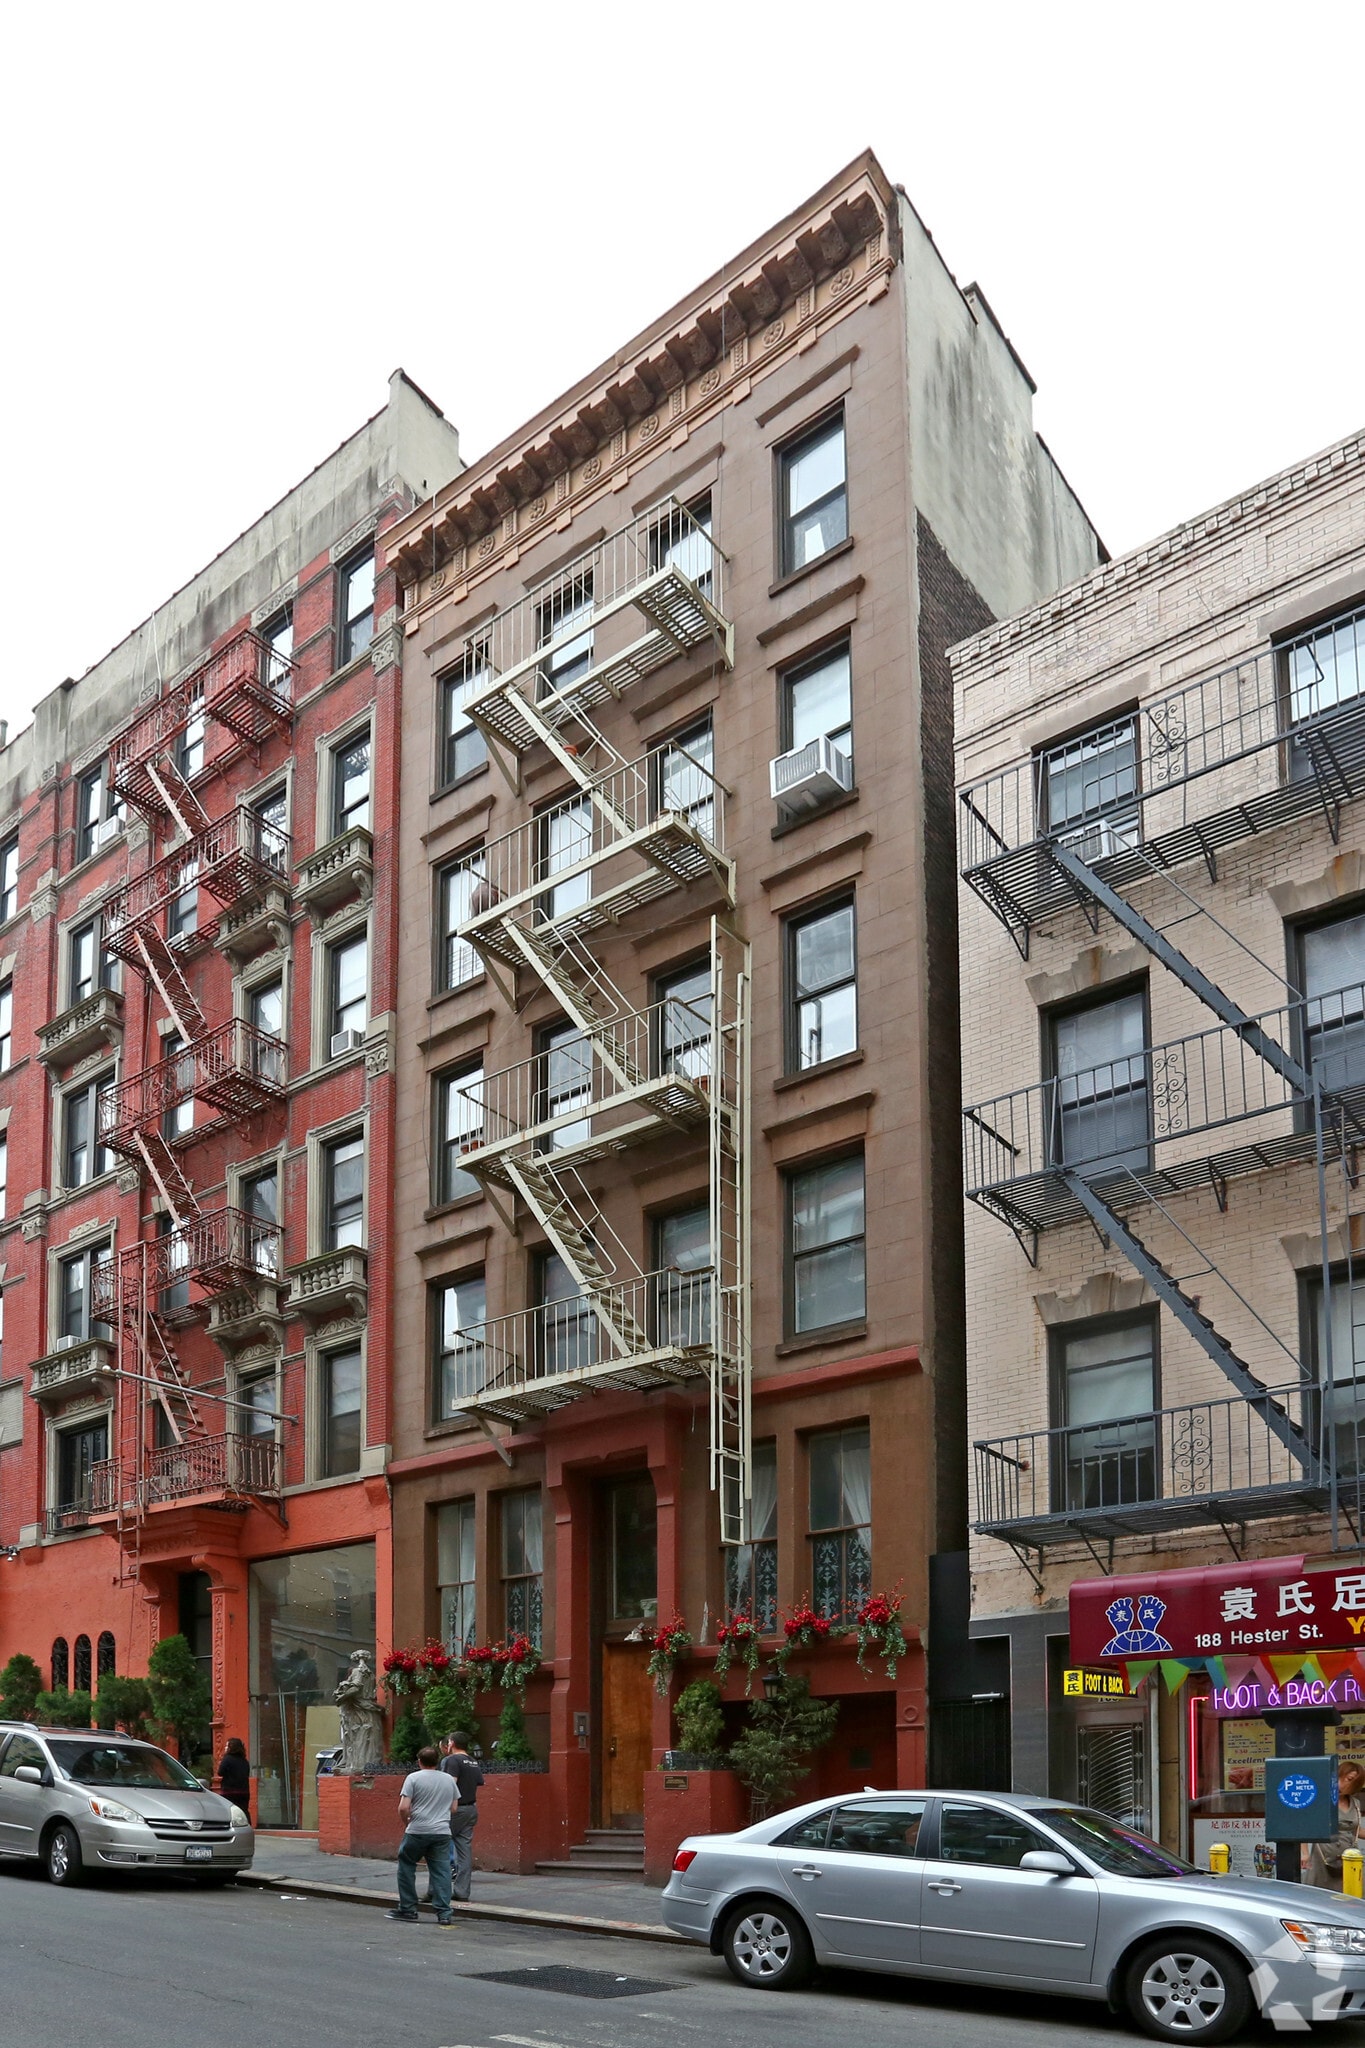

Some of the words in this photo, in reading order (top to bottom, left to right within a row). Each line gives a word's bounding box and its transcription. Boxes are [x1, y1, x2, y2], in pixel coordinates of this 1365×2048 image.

[1347, 1616, 1365, 1634] Y
[1195, 1633, 1222, 1648] 188
[1230, 1629, 1289, 1645] Hester
[1299, 1624, 1324, 1639] St.
[1085, 1674, 1102, 1692] FOOT
[1103, 1675, 1107, 1692] &
[1108, 1676, 1124, 1694] BACK
[1267, 1684, 1281, 1706] &
[1287, 1680, 1337, 1706] BACK
[1284, 1780, 1293, 1790] P
[1211, 1821, 1265, 1829] 足部反射区
